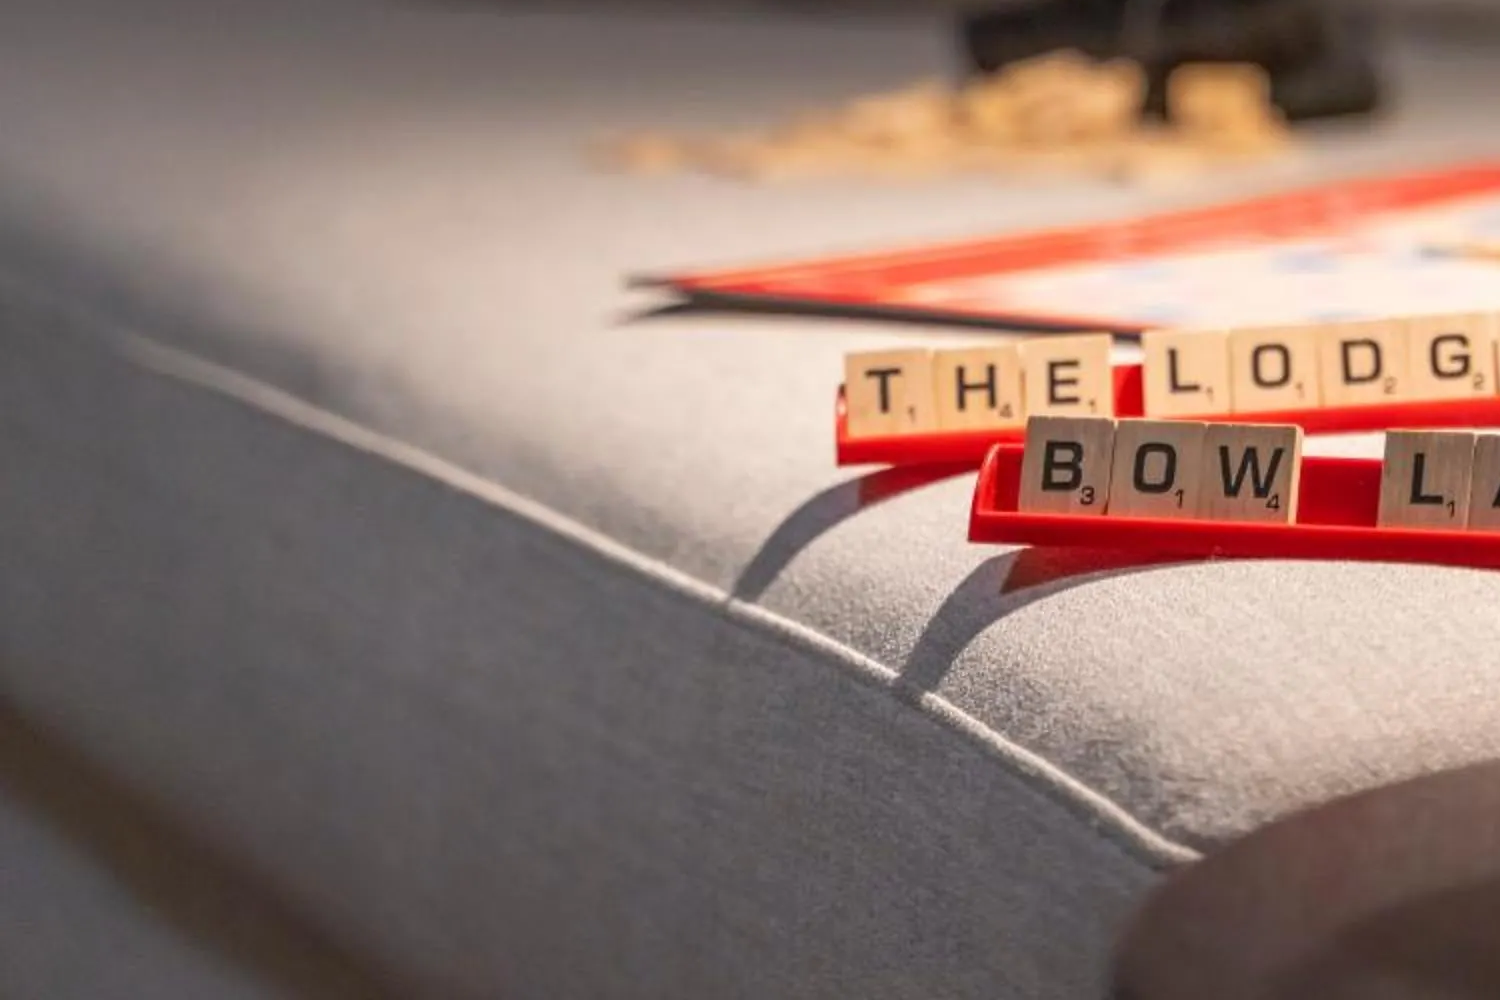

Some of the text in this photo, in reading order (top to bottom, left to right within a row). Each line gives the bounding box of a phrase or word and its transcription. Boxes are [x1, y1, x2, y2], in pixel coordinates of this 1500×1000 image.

[865, 360, 1080, 414] THE
[1205, 388, 1214, 404] 1
[1384, 378, 1397, 394] 2
[1473, 374, 1485, 391] 2
[1041, 440, 1285, 499] BOW
[1080, 486, 1095, 505] 3
[1175, 489, 1184, 508] 1
[1265, 494, 1280, 512] 4
[1447, 500, 1455, 517] 1
